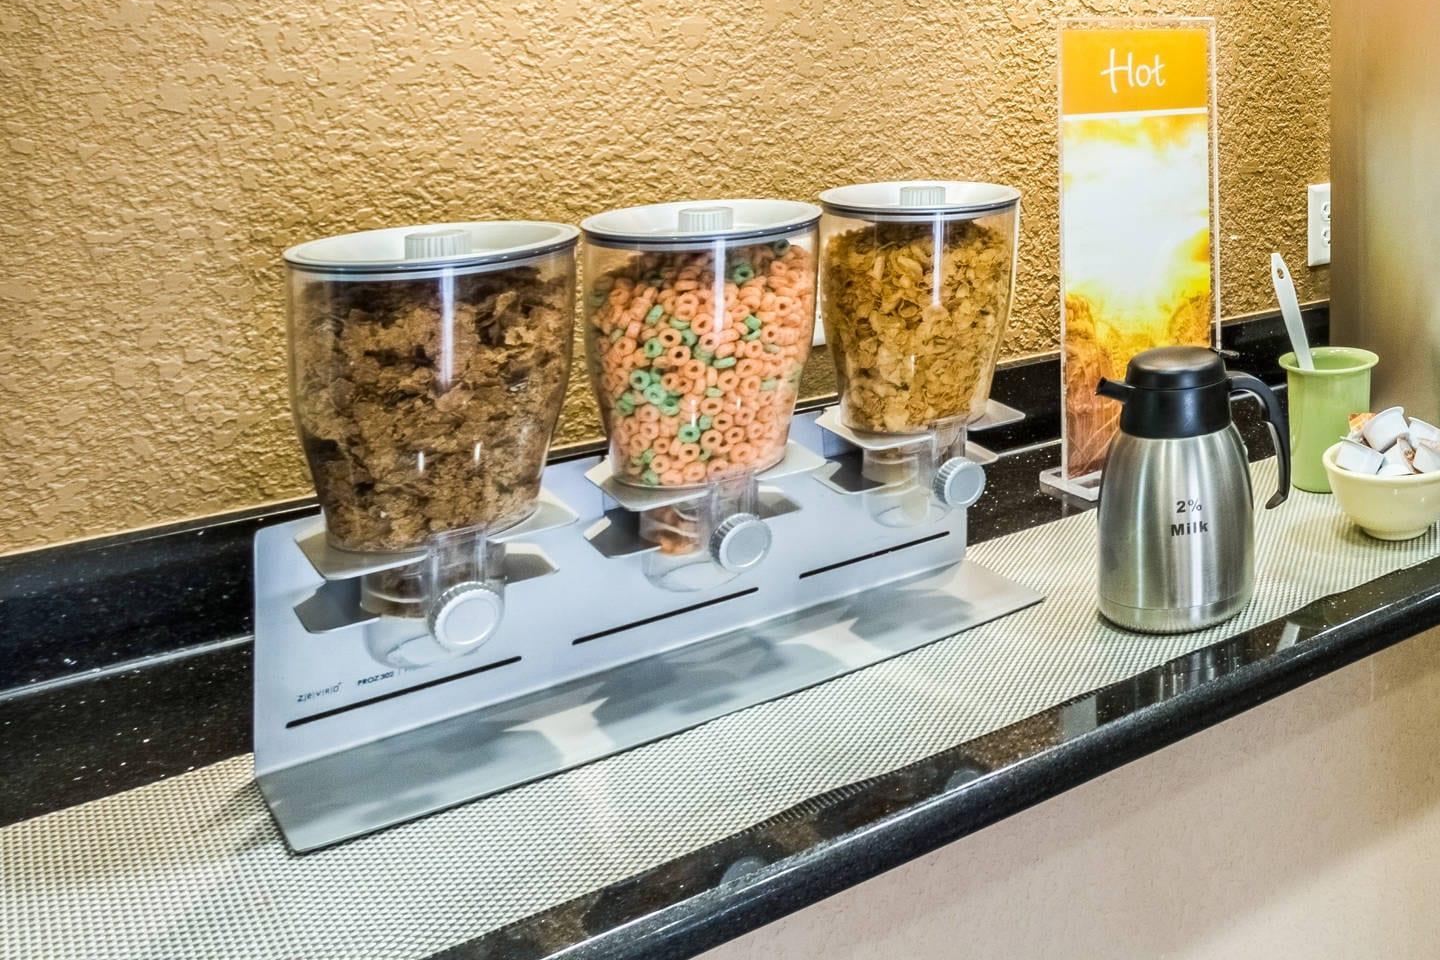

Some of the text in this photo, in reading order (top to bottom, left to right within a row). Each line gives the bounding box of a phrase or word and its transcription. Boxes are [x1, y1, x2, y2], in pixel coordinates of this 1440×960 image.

[1100, 48, 1166, 94] Hot
[1176, 499, 1202, 513] 2%
[1170, 520, 1208, 537] Milk
